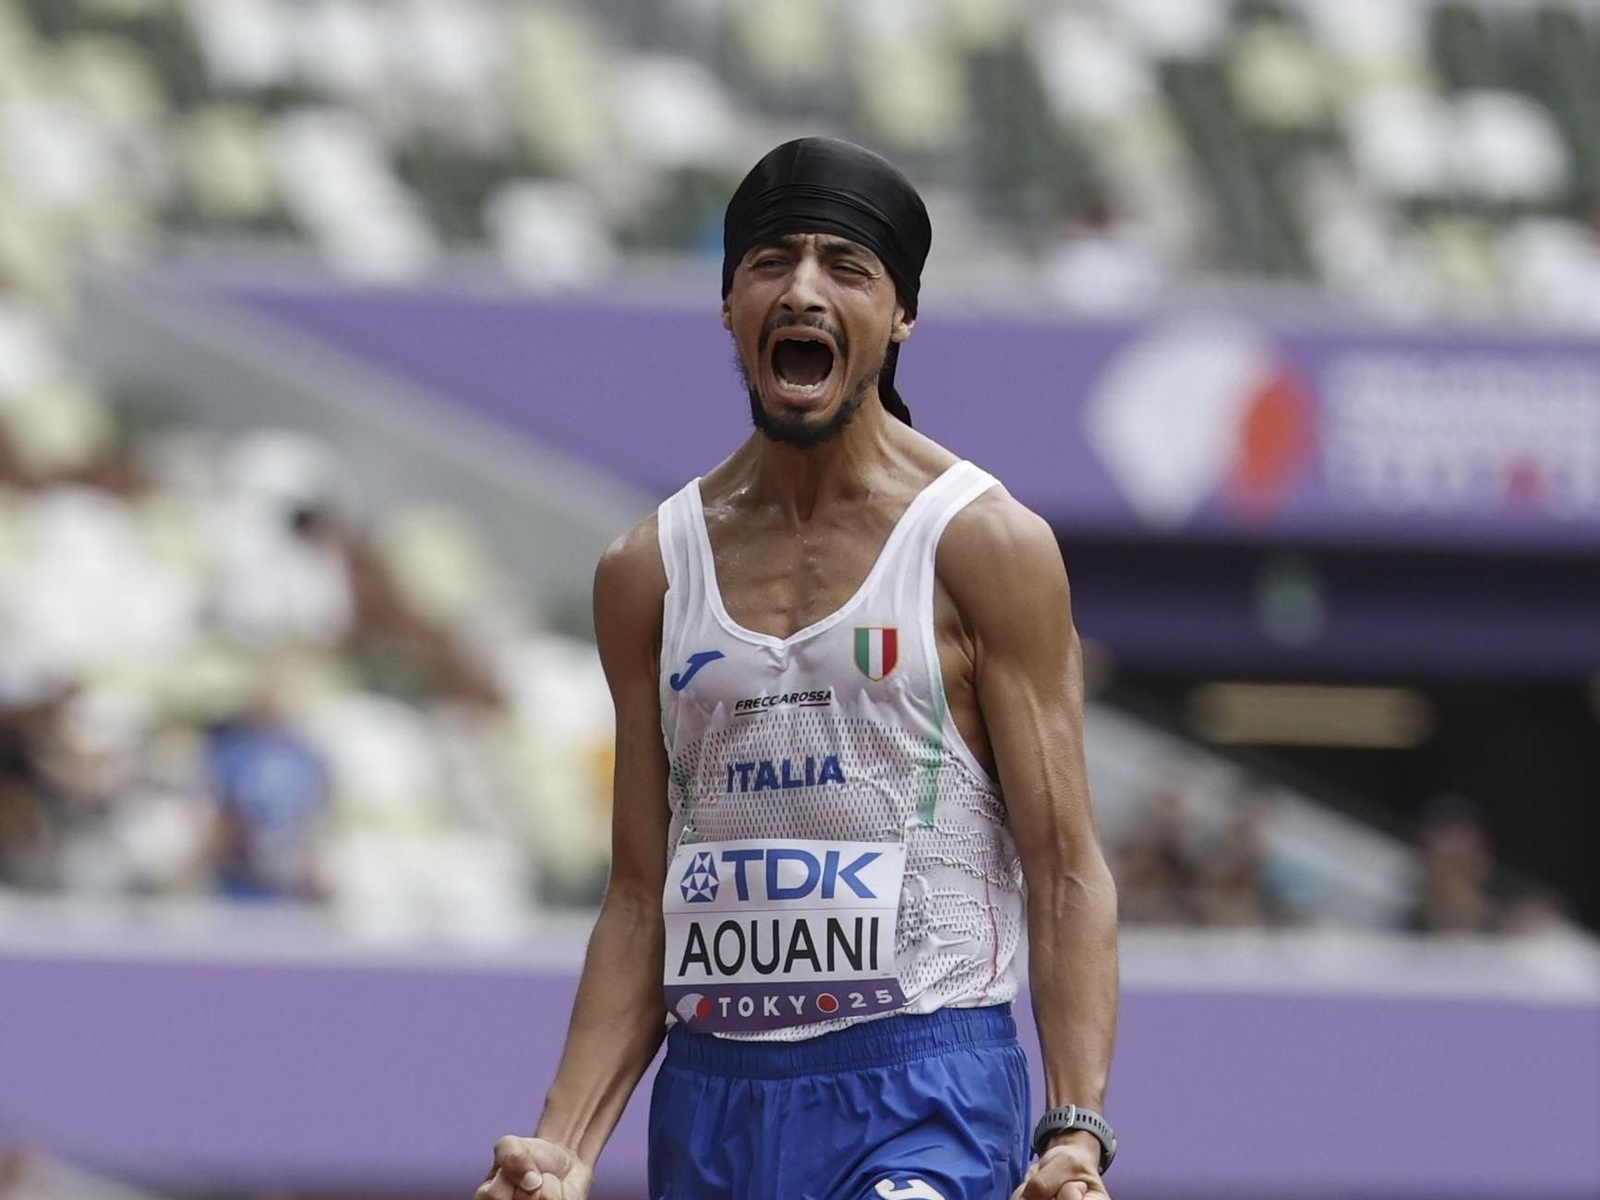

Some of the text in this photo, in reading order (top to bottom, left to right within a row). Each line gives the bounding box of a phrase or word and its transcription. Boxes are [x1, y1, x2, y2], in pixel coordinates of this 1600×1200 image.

[735, 690, 832, 712] FRECCAROSSA
[727, 754, 846, 793] ITALIA
[721, 849, 882, 901] TDK
[678, 916, 879, 976] AOUANI
